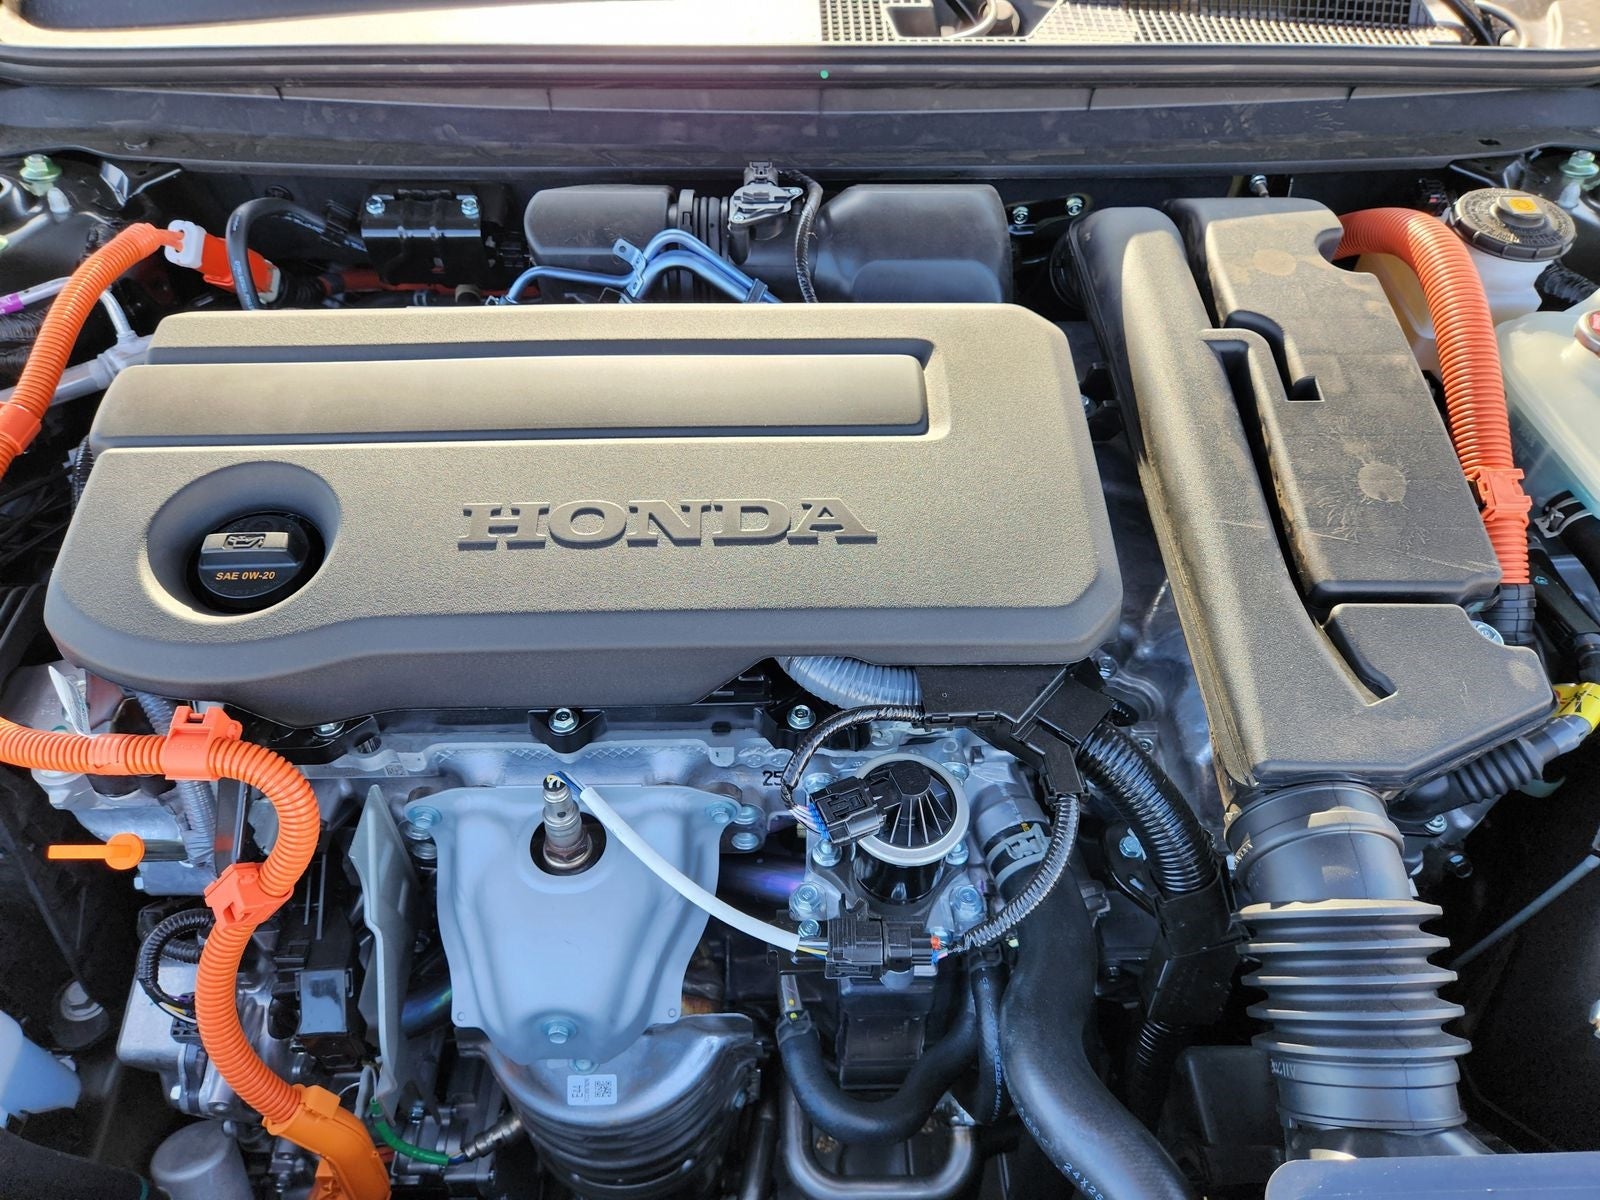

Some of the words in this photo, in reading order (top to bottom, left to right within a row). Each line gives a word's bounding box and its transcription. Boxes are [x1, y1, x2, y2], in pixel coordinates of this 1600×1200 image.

[457, 497, 878, 550] HONDA
[215, 571, 240, 581] SAE
[241, 571, 276, 580] 0W-20
